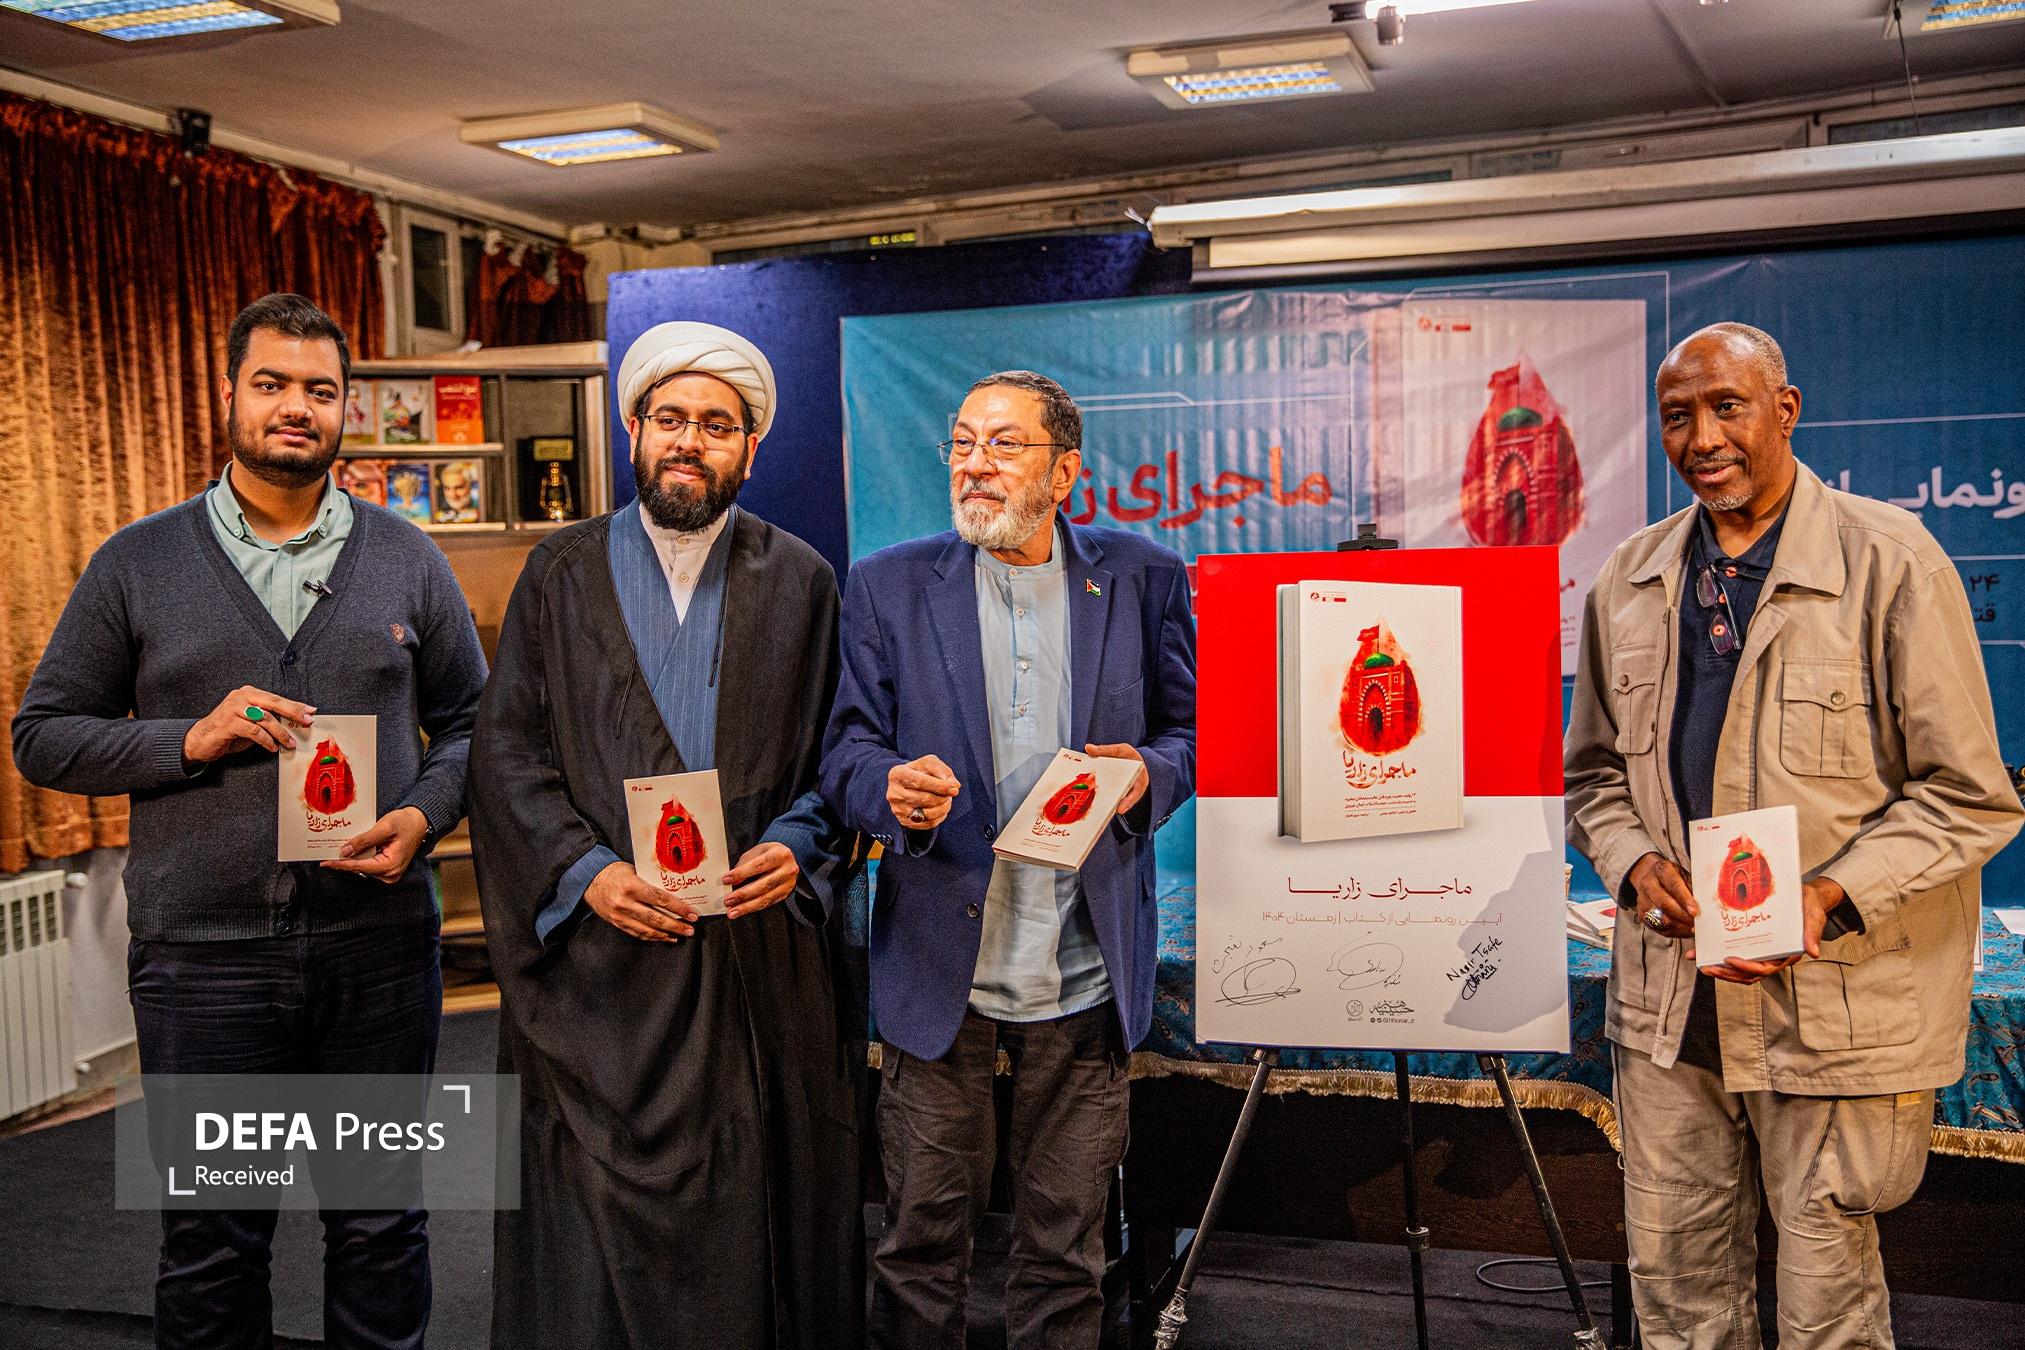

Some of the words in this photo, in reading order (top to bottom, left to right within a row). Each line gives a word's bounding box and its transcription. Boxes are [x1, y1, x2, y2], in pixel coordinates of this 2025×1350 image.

[1106, 446, 1333, 530] ماجرای
[1970, 574, 2000, 592] ۲۴
[1342, 750, 1367, 782] زاریا
[1345, 760, 1417, 789] ماجرای
[307, 816, 352, 833] ماجرای
[1287, 877, 1362, 900] زاریا
[1367, 877, 1472, 900] ماجرای
[1262, 911, 1286, 921] ۱۴۰۴
[1286, 911, 1338, 926] زمستان
[1343, 912, 1386, 925] کتاب
[1395, 913, 1457, 927] رونمایی
